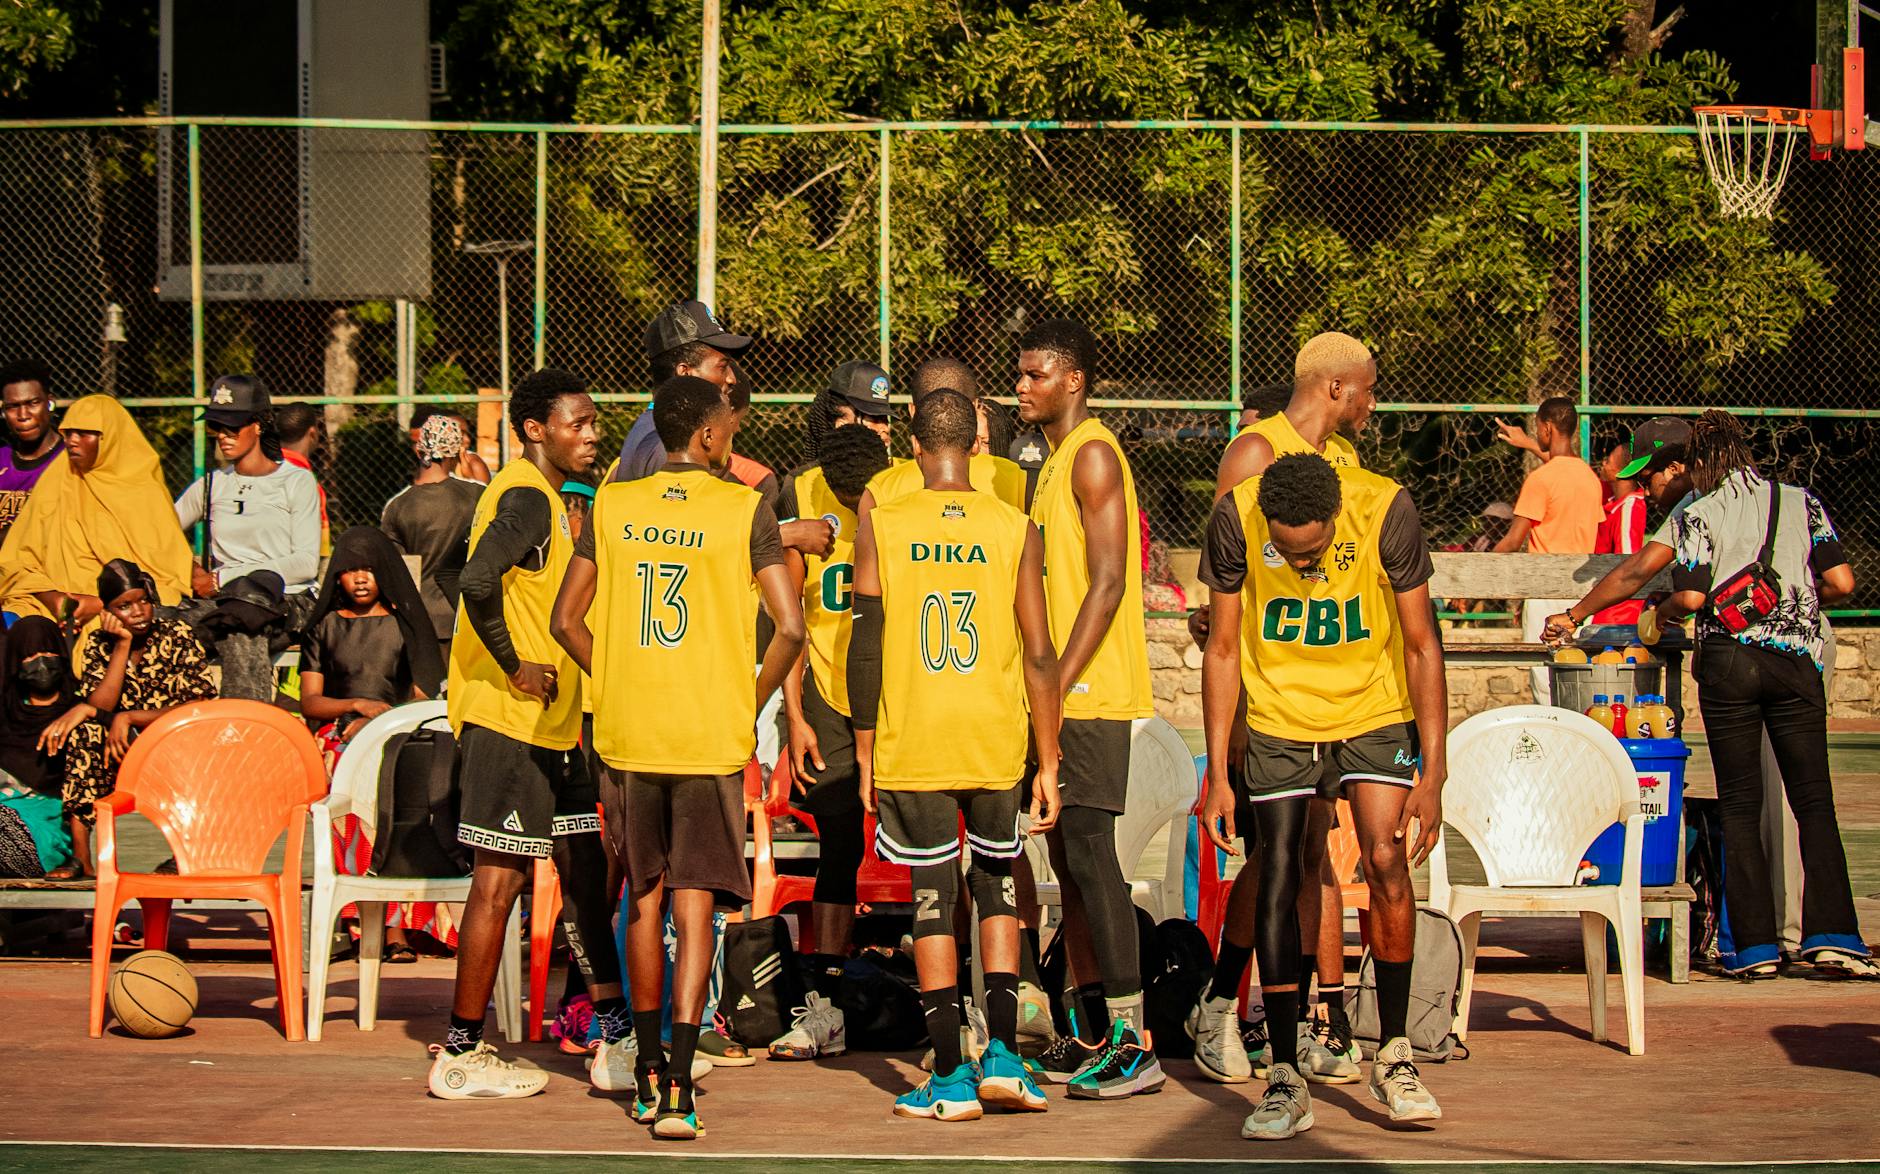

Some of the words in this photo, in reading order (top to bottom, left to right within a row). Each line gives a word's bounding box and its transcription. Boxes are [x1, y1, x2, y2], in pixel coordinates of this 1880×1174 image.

[623, 523, 705, 549] S.OGIJI
[910, 542, 988, 564] DIKA
[637, 562, 689, 648] 13
[1262, 592, 1372, 648] CBL
[920, 589, 979, 675] 03
[914, 888, 941, 922] 2
